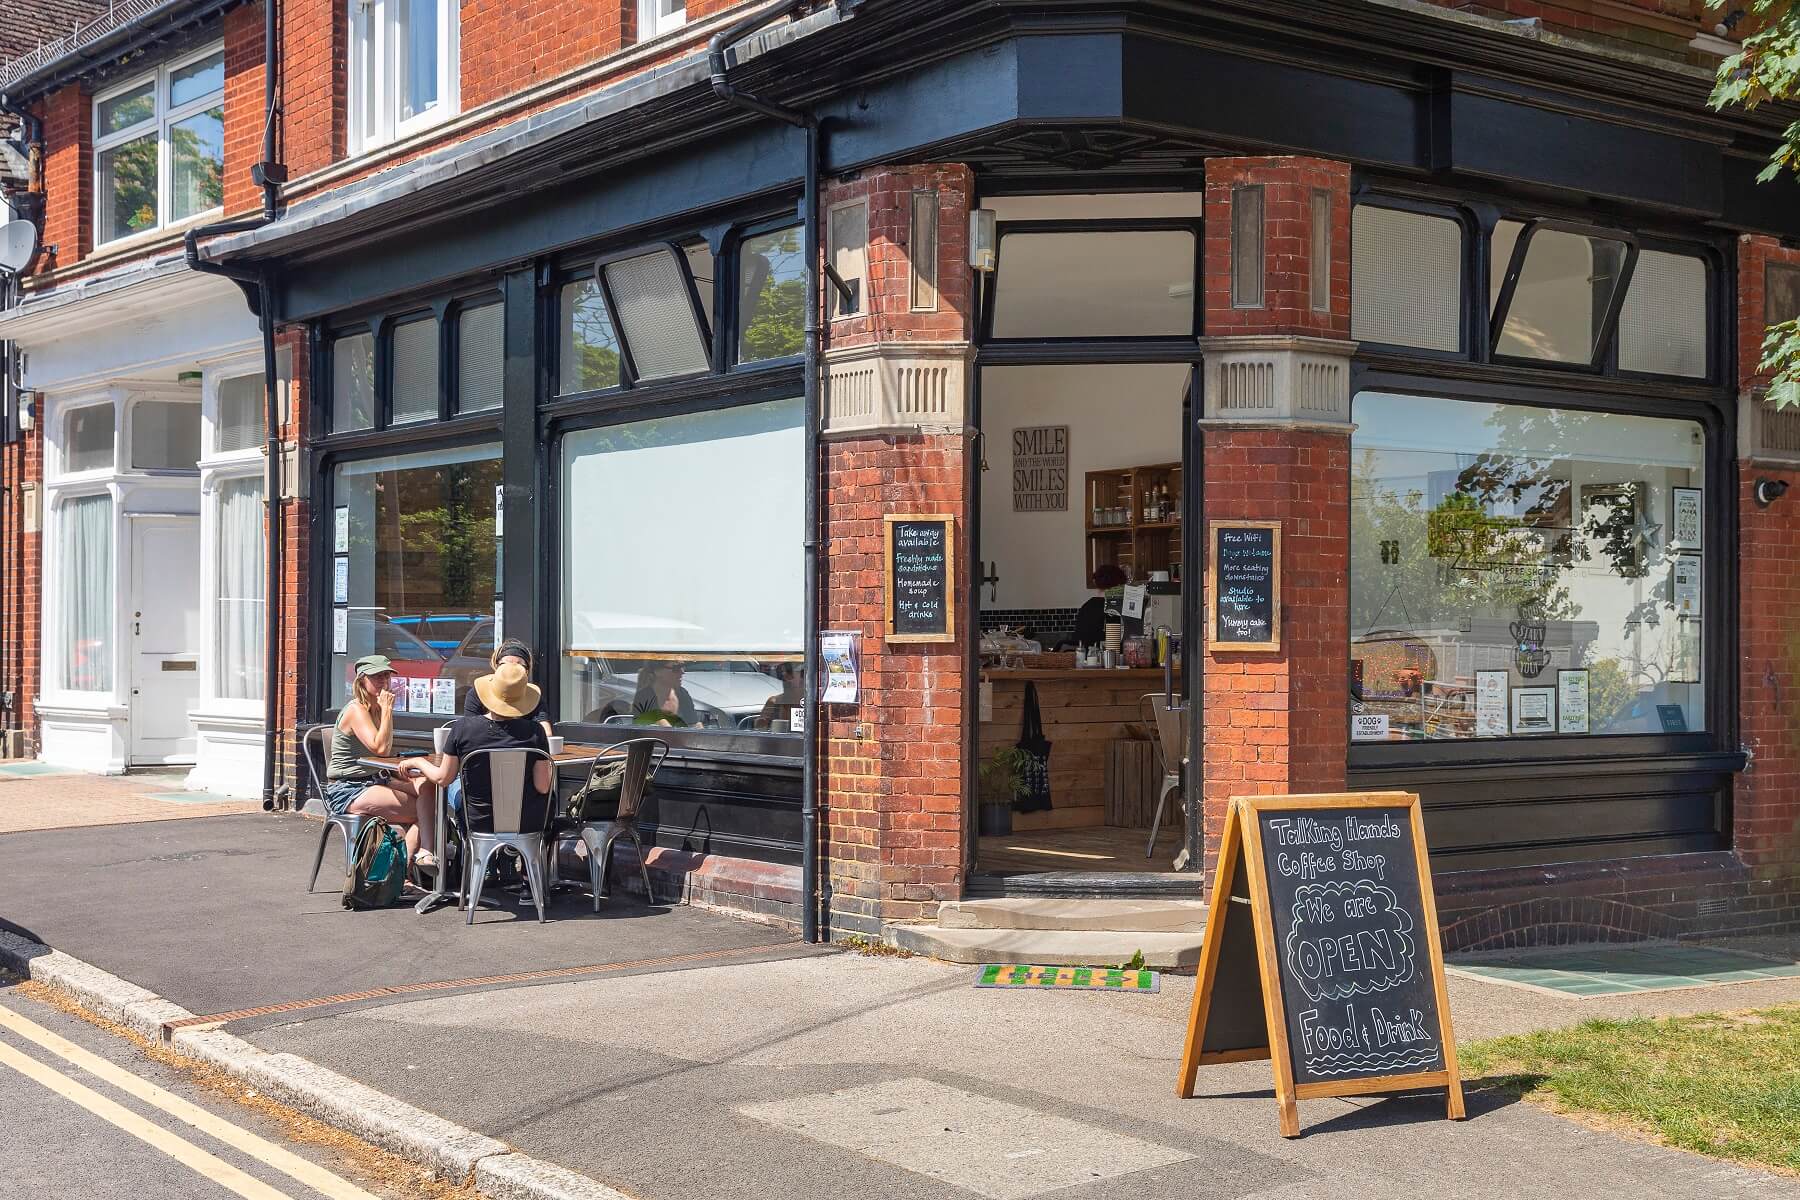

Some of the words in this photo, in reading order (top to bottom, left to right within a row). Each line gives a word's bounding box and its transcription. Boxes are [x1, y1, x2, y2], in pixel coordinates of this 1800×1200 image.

[1013, 428, 1065, 456] SMILE
[1013, 468, 1065, 492] SMILES
[1014, 493, 1042, 510] WITH
[1045, 492, 1065, 509] YOU
[897, 537, 940, 547] available
[896, 552, 922, 565] Freshly
[925, 553, 944, 562] made
[897, 577, 940, 588] Homemade
[908, 588, 928, 597] soup
[908, 610, 933, 618] drinks
[1518, 625, 1544, 642] START
[1362, 716, 1376, 725] DOG
[1345, 813, 1401, 841] Hands
[1277, 852, 1336, 879] Coffee
[1341, 849, 1386, 880] Shop
[1305, 898, 1335, 924] We
[1344, 896, 1377, 918] are
[1298, 929, 1396, 980] OPEN
[1299, 1003, 1360, 1055] Food
